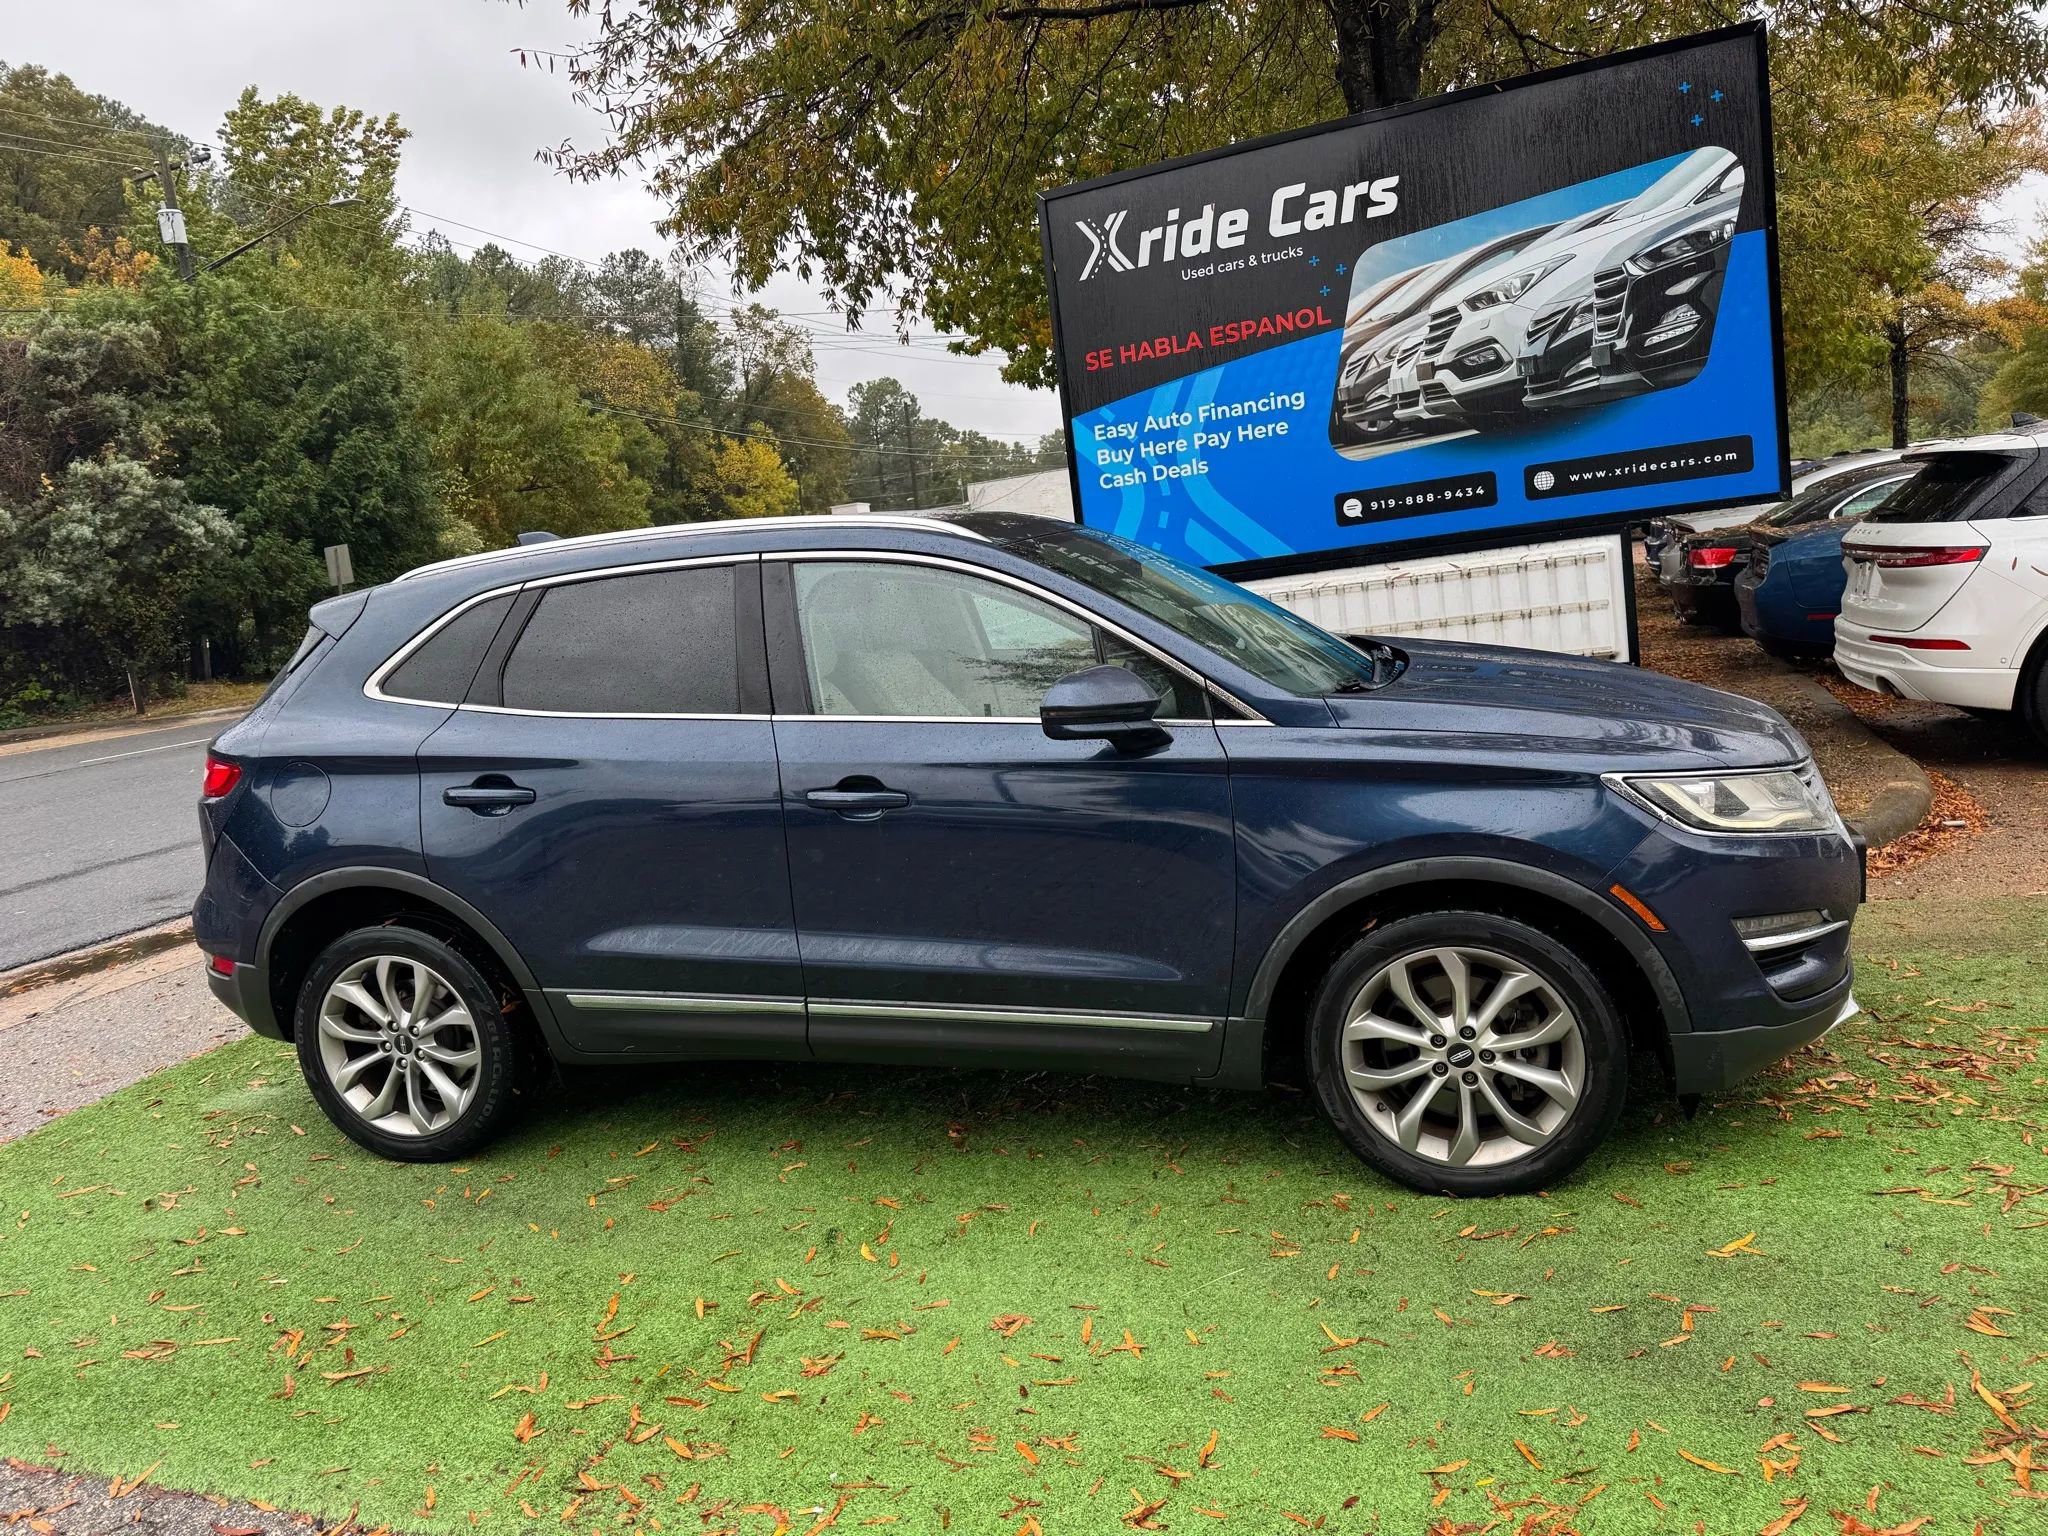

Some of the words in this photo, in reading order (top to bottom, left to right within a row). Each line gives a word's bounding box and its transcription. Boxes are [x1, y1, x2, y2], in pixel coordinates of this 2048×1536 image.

[1269, 175, 1399, 237] Cars
[1181, 262, 1214, 280] Used
[1217, 256, 1245, 273] cars
[1248, 254, 1258, 267] &
[1261, 245, 1303, 264] trucks
[1085, 348, 1113, 371] SE
[1119, 331, 1204, 365] HABLA
[1209, 305, 1332, 346] ESPANOL
[1094, 420, 1138, 441] Easy
[1143, 411, 1192, 433] Auto
[1198, 391, 1305, 422] Financing
[1097, 447, 1134, 465] Buy
[1140, 438, 1188, 458] Here
[1194, 430, 1231, 450] Pay
[1238, 421, 1289, 442] Here
[1099, 467, 1147, 489] Cash
[1152, 458, 1209, 481] Deals
[1569, 450, 1738, 482] www.xridecars.com
[1370, 485, 1486, 511] 919-888-9434
